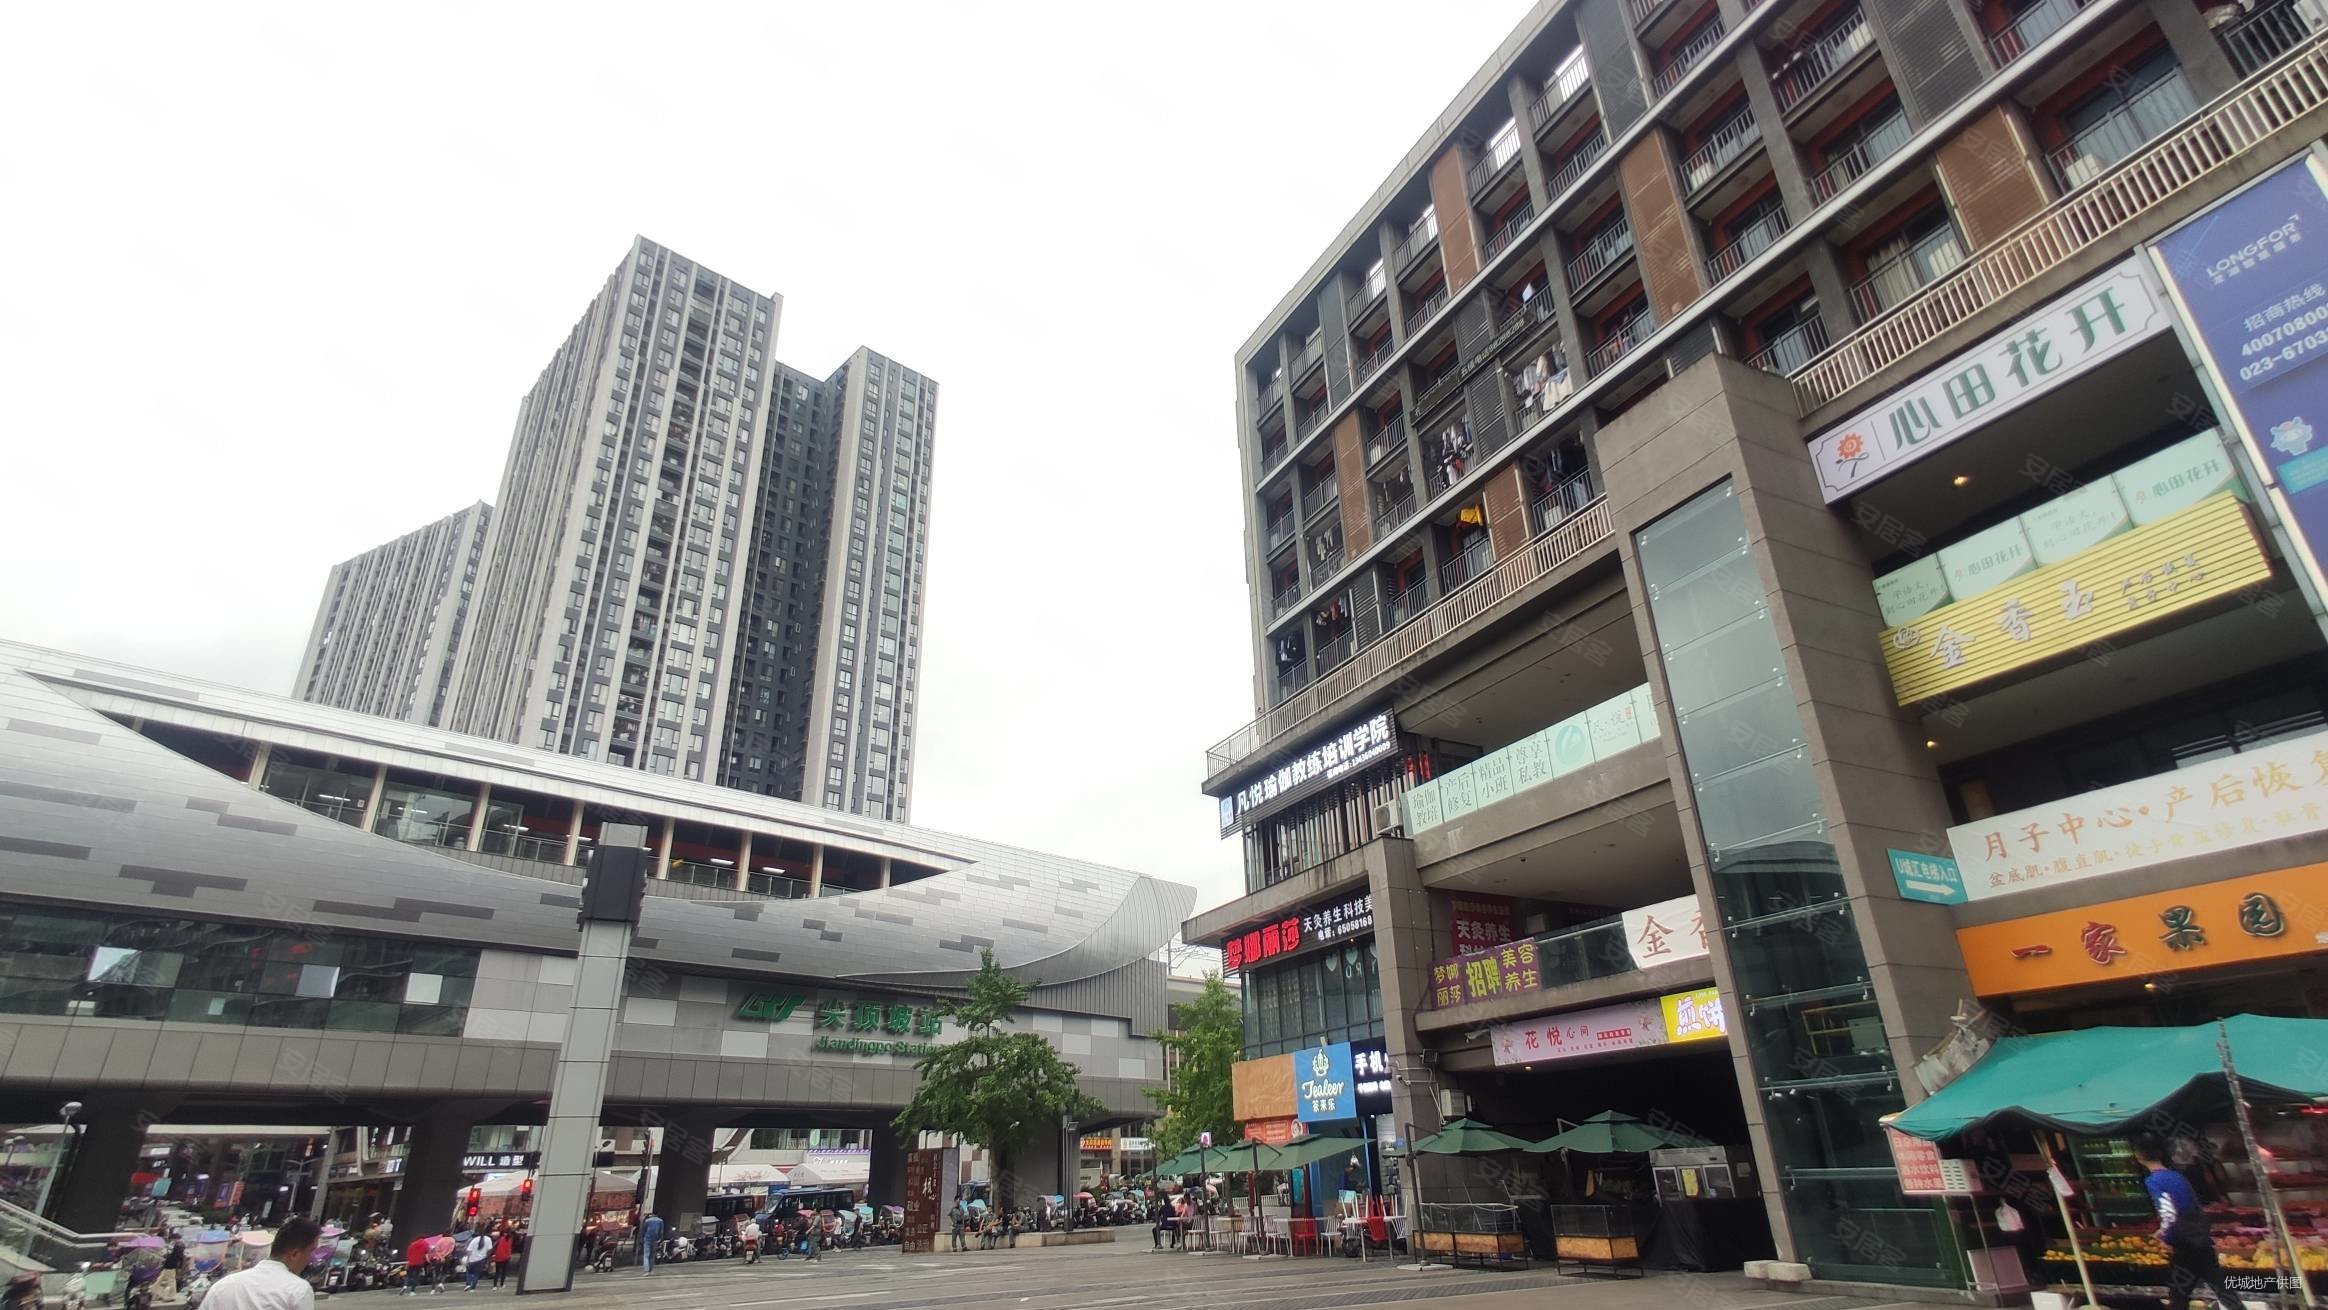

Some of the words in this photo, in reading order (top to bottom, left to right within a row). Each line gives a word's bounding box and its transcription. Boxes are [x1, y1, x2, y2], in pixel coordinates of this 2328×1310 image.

[2206, 222, 2296, 278] LONGFOR
[2244, 283, 2326, 332] 招商热线
[2241, 303, 2328, 357] 40070800
[1889, 286, 2127, 452] 心田花开
[2239, 328, 2328, 381] 023-6703
[2151, 458, 2221, 497] 心田花开
[1237, 714, 1390, 816] 凡悦瑜伽教练培训学院
[1482, 780, 1508, 800] 小班
[1226, 916, 1300, 969] 梦娜丽莎
[2010, 892, 2285, 966] 一家果园
[1501, 943, 1534, 968] 美容
[1436, 984, 1461, 1007] 丽莎
[1465, 956, 1500, 998] 招聘
[1505, 968, 1538, 993] 养生
[818, 997, 942, 1036] 尖顶坡站
[1676, 996, 1727, 1037] 煎饼
[1354, 1050, 1389, 1076] 手机
[1301, 1079, 1345, 1099] Tealeer
[463, 1156, 496, 1167] WILL
[499, 1155, 525, 1167] 造型
